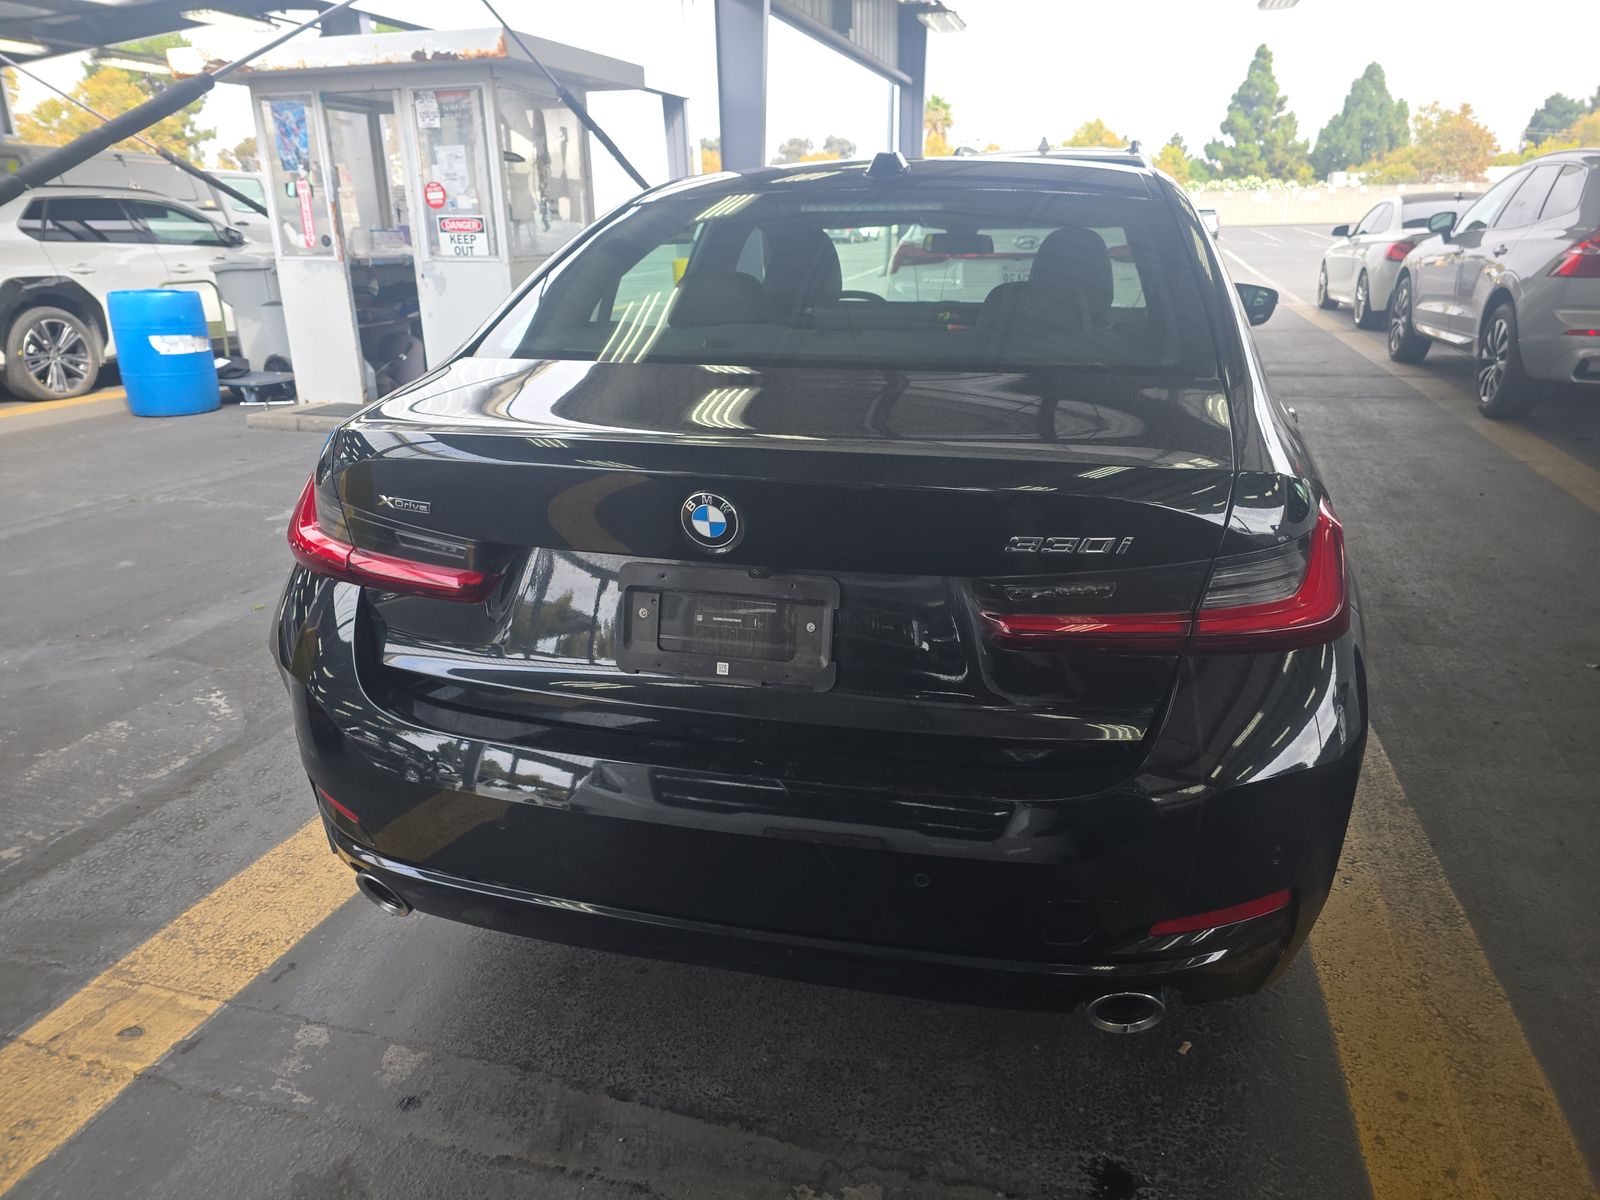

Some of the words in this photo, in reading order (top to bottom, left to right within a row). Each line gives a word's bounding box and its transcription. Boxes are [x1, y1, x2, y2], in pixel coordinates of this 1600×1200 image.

[445, 221, 479, 230] DANGER
[449, 234, 477, 244] KEEP
[454, 245, 474, 256] OUT
[685, 495, 733, 513] BMW
[1004, 536, 1134, 554] 330i
